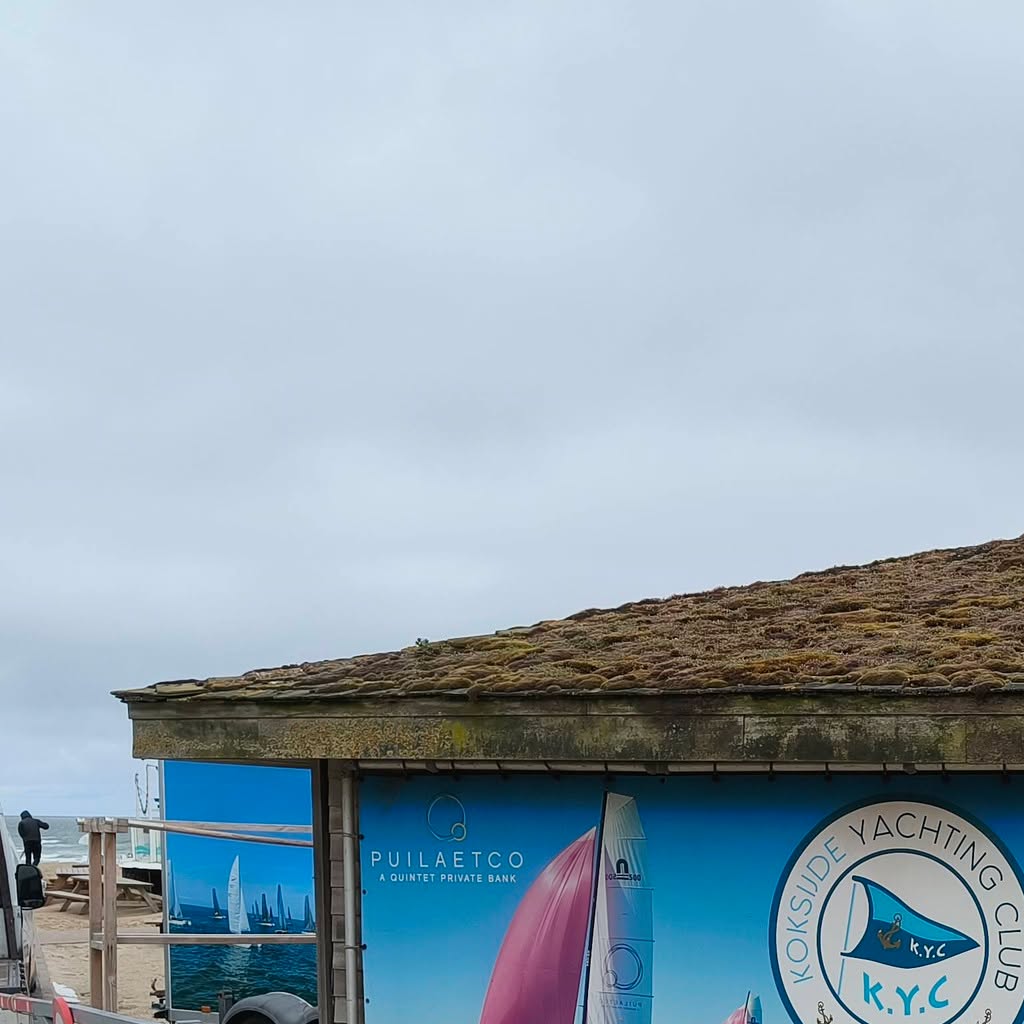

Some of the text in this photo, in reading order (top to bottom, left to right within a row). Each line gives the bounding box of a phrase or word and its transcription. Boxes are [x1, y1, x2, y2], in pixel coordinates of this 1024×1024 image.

[371, 851, 524, 869] PUILAETCO
[379, 874, 517, 883] A QUINTET PRIVATE BANK
[786, 812, 1022, 992] KOKSIJDE YACHTING CLUB
[862, 971, 950, 1016] K.Y.C
